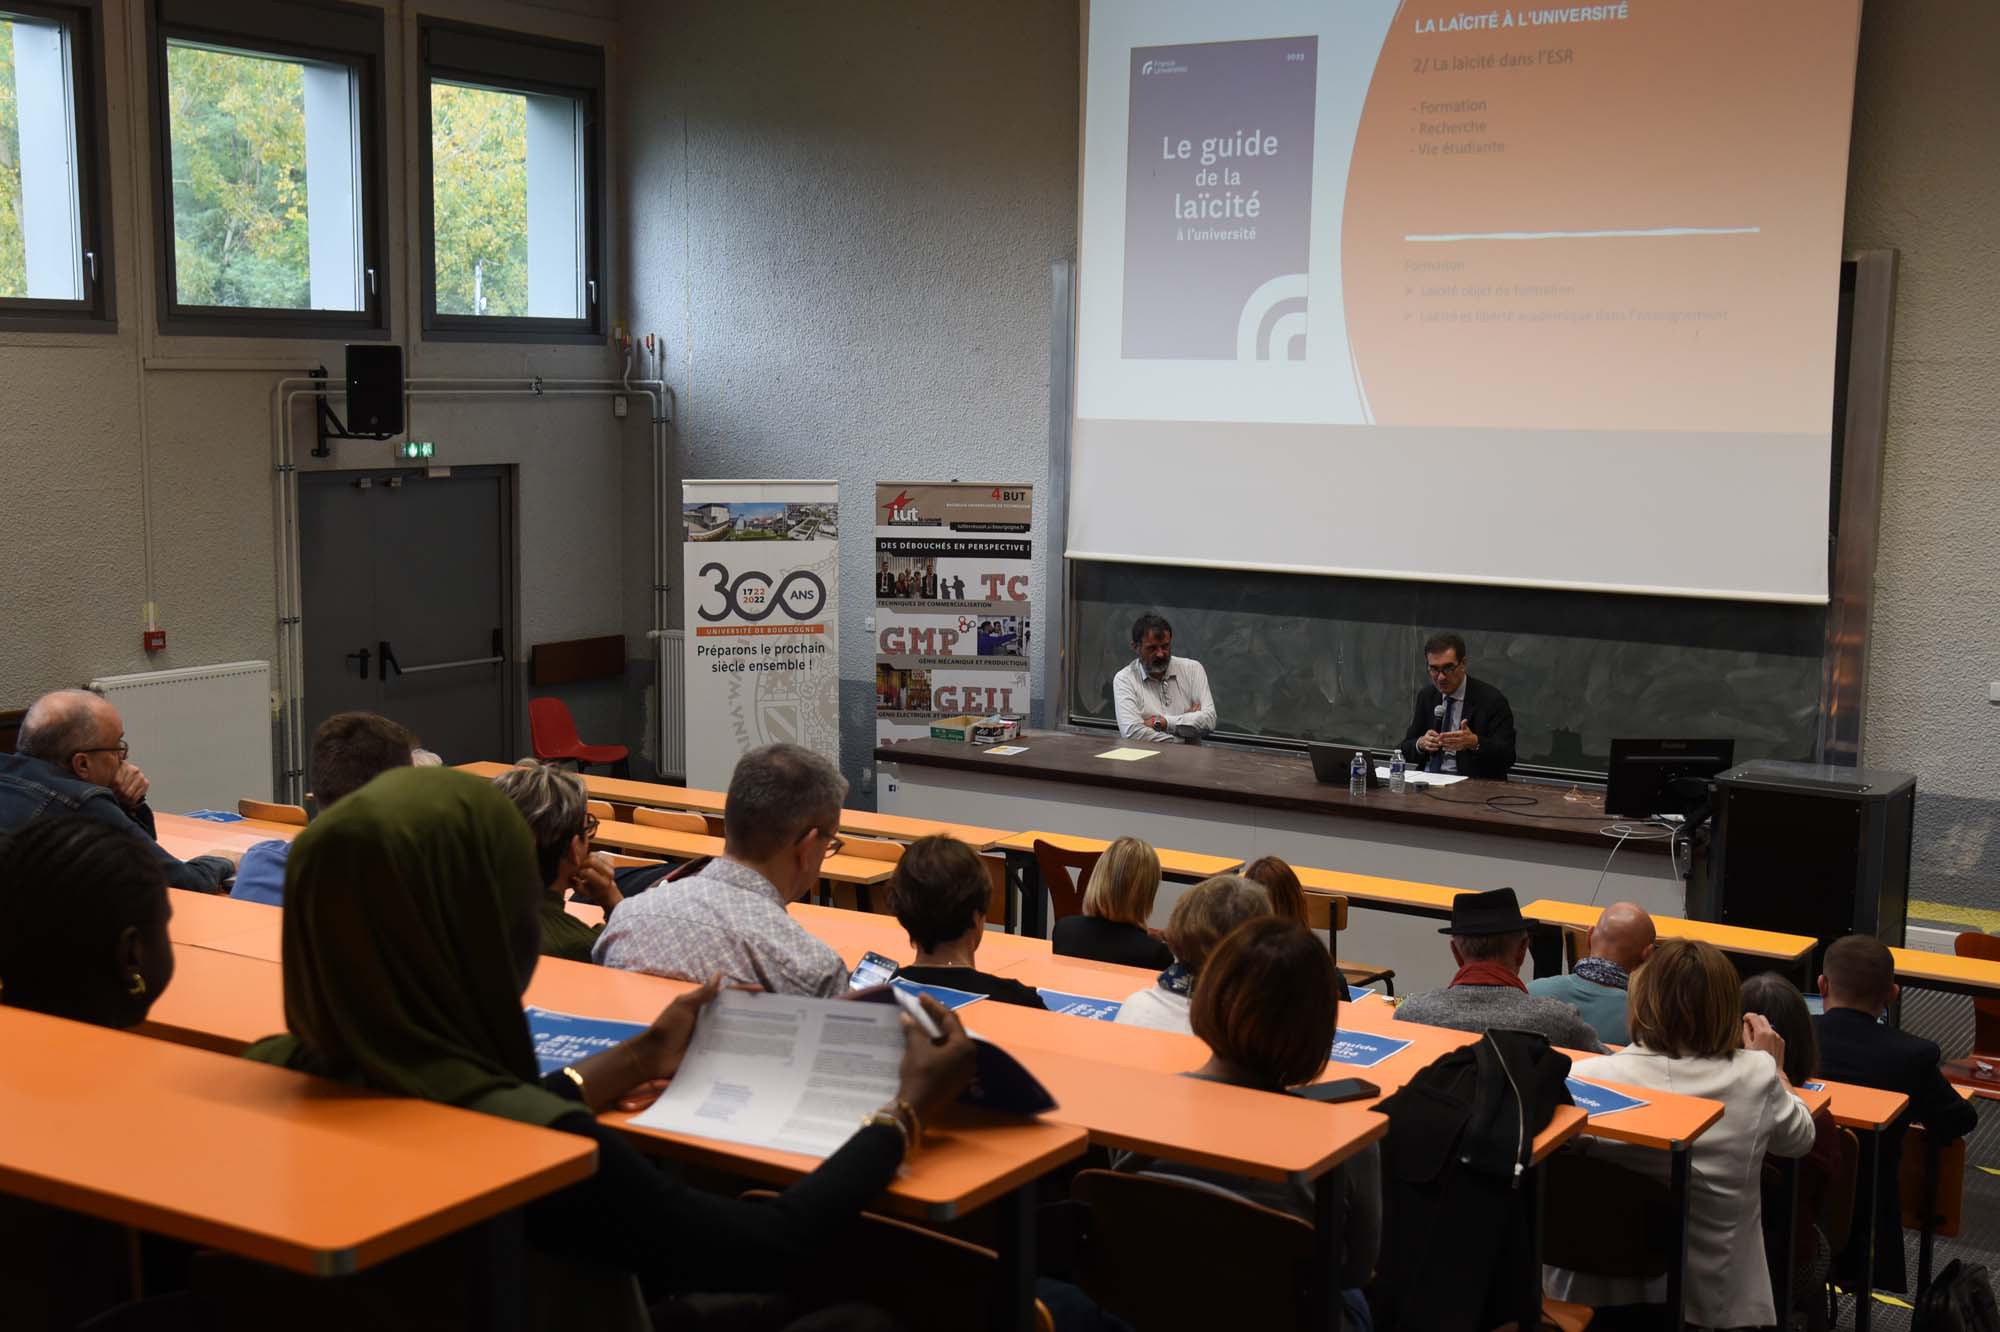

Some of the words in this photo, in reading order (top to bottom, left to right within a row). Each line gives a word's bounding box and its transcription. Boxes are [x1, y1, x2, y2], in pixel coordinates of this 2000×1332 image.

[1415, 18, 1436, 33] LA
[1439, 12, 1499, 32] LAÏCITÉ
[1502, 10, 1514, 28] À
[1518, 1, 1629, 27] L'UNIVERSITÉ
[1433, 57, 1449, 72] La
[1499, 52, 1534, 68] dans
[1420, 98, 1488, 114] Formation
[1419, 119, 1488, 135] Recherche
[1163, 136, 1192, 160] Le
[1200, 129, 1279, 165] guide
[1418, 143, 1439, 156] Vie
[1195, 168, 1218, 186] de
[1224, 167, 1241, 185] la
[1175, 190, 1261, 219] laïcité
[1187, 226, 1257, 241] l'université
[991, 487, 1002, 501] 4
[1003, 491, 1026, 501] BUT
[893, 505, 918, 522] iut
[881, 542, 897, 550] DES
[900, 540, 951, 550] DÉBOUCHÉS
[954, 542, 967, 550] EN
[969, 543, 1025, 551] PERSPECTIVE
[698, 562, 827, 622] 300
[742, 588, 765, 596] 1722
[790, 590, 815, 600] ANS
[980, 573, 1029, 601] TC
[767, 626, 815, 634] BOURGOGNE
[879, 627, 960, 656] GMP
[697, 643, 758, 658] Préparons
[761, 643, 771, 655] le
[774, 642, 825, 656] prochain
[712, 660, 745, 672] siècle
[749, 658, 806, 672] ensemble
[984, 659, 1028, 667] PRODUCTIQUE
[934, 686, 1013, 713] GEII
